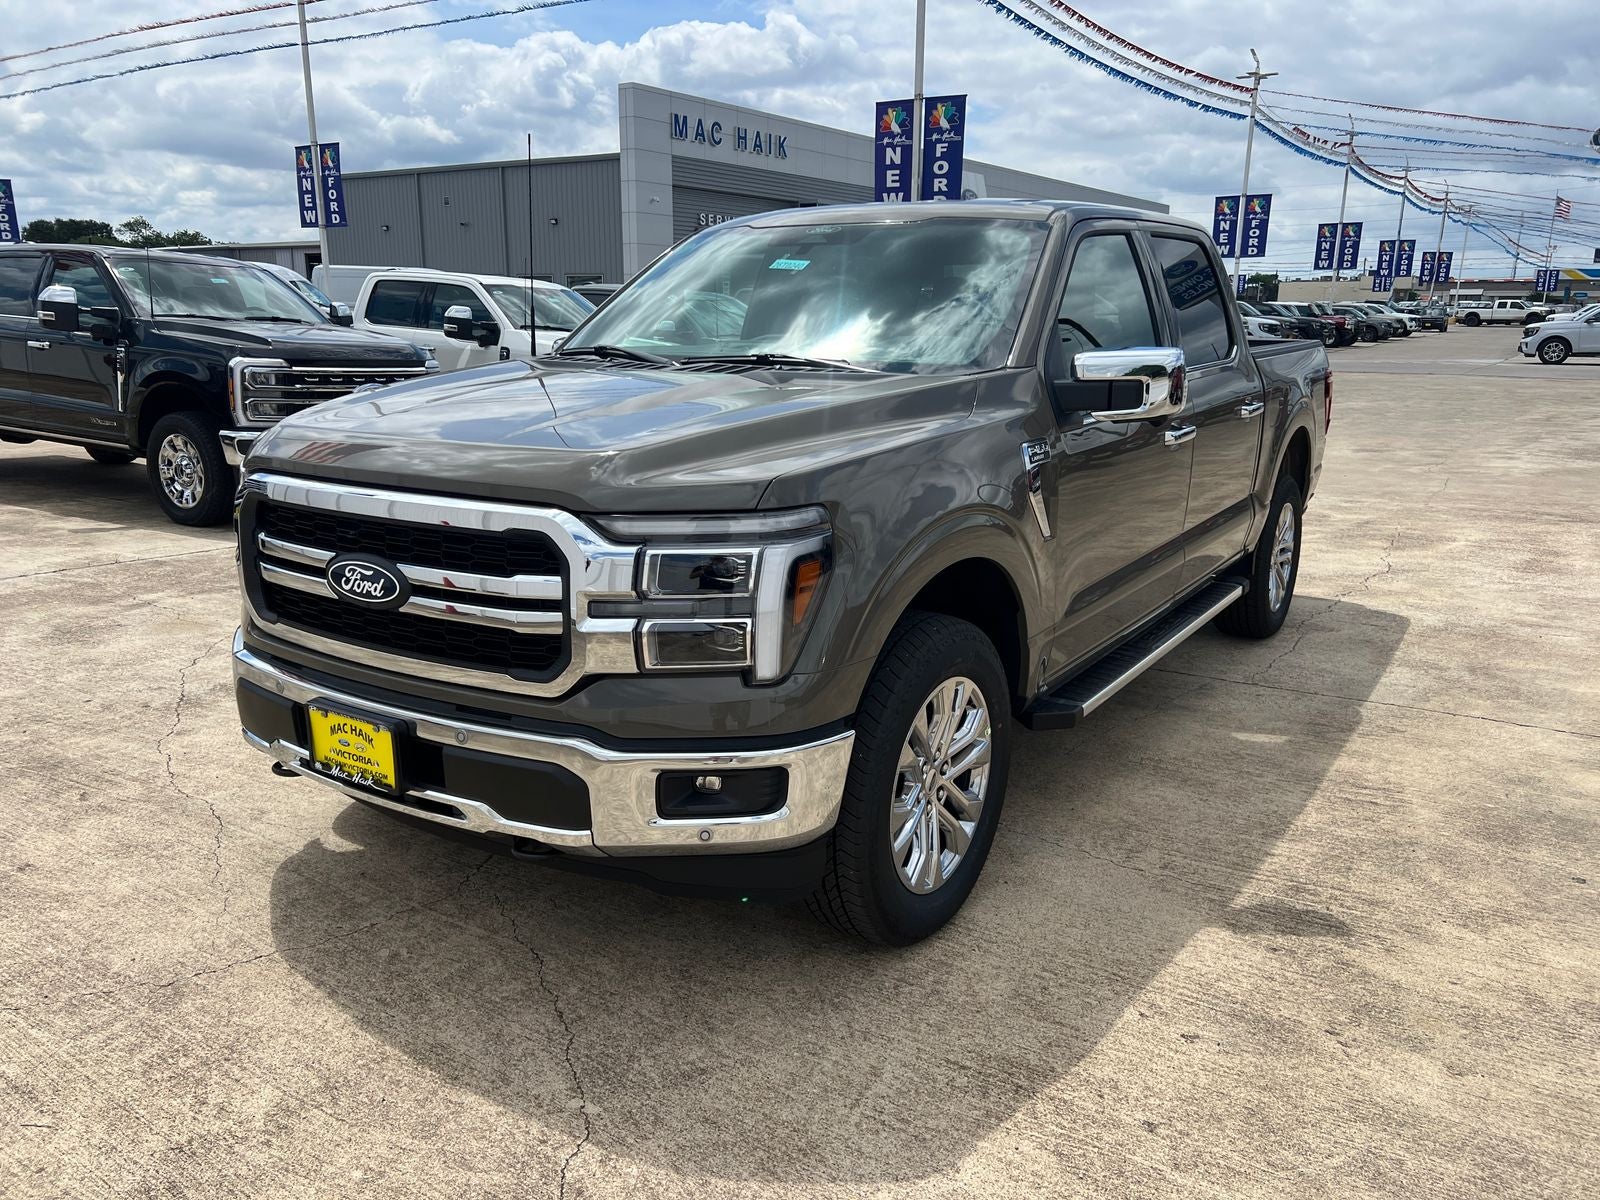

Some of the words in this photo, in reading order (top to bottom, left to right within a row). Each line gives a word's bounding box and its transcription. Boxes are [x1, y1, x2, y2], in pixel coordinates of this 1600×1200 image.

[673, 113, 722, 146] MAC
[736, 126, 787, 158] HAIK
[302, 177, 316, 223] NEW
[327, 177, 340, 224] FORD
[1217, 220, 1230, 255] NEW
[1247, 219, 1260, 255] FORD
[1318, 241, 1330, 268] NEW
[1343, 240, 1354, 268] FORD
[1380, 254, 1390, 276] NEW
[1400, 254, 1409, 276] FORD
[1422, 264, 1430, 281] NEW
[1438, 263, 1447, 282] FORD
[341, 565, 385, 597] Ford
[330, 722, 348, 736] MAC
[350, 724, 375, 749] HAIK
[335, 749, 373, 766] VICTORIA
[329, 764, 352, 780] Mac
[352, 773, 376, 787] Haik
